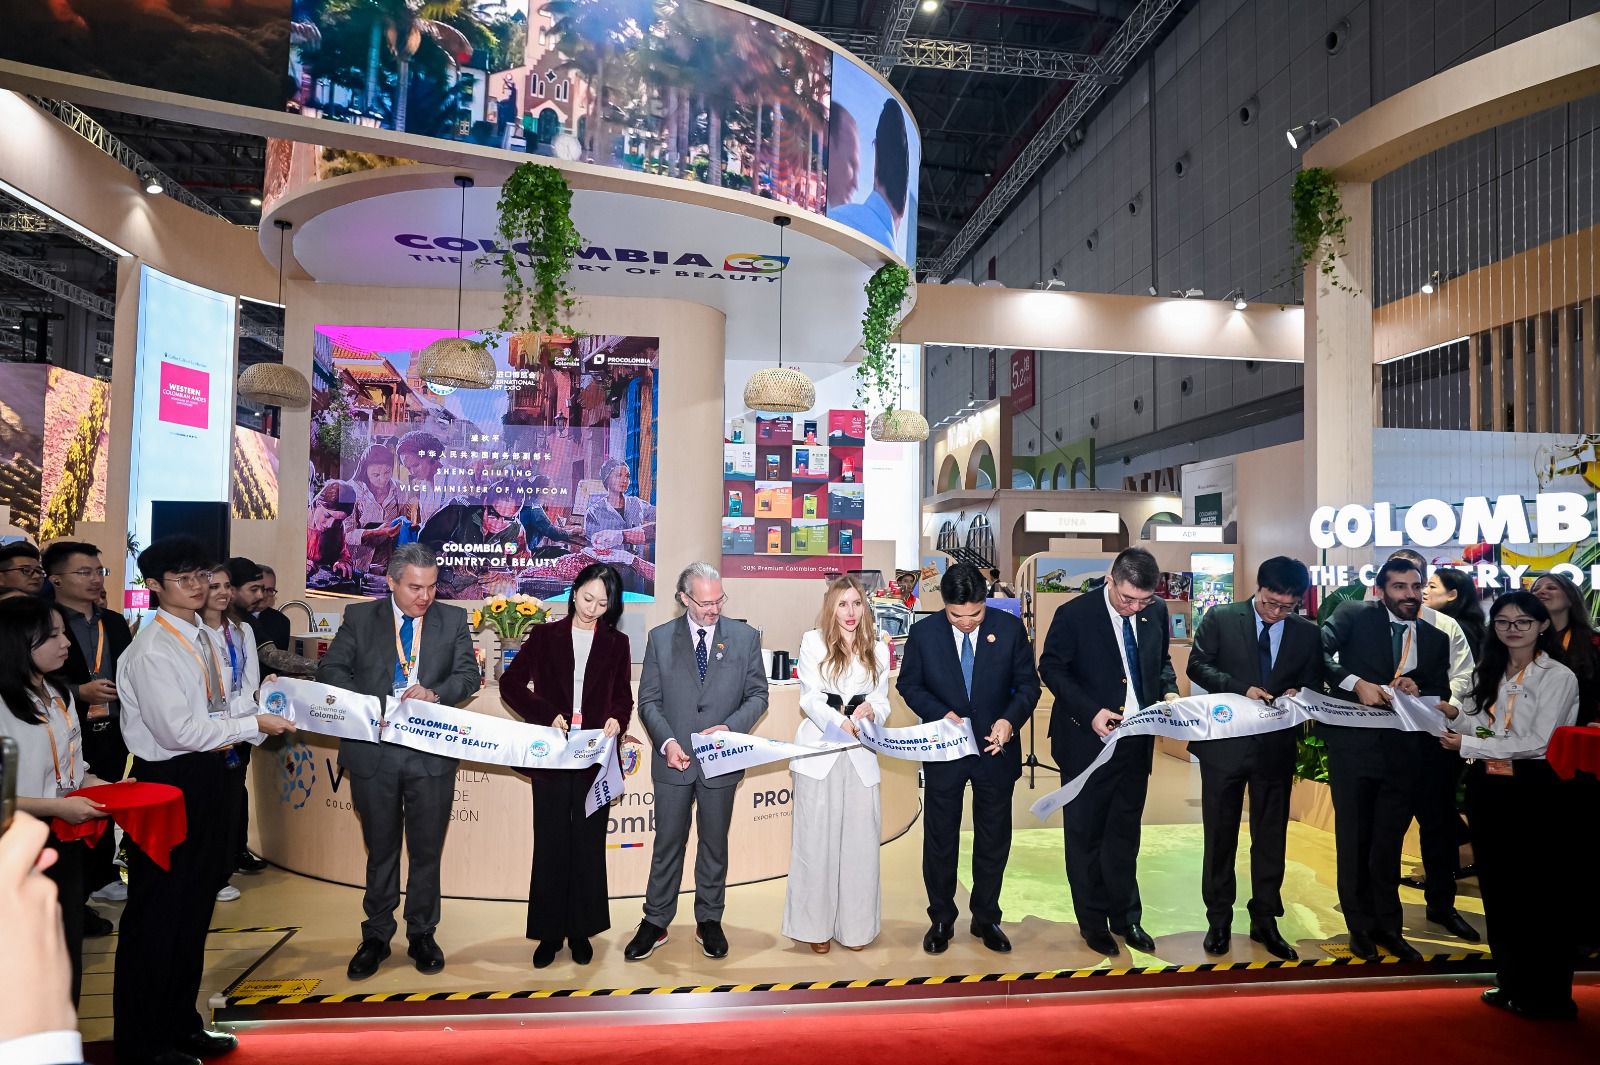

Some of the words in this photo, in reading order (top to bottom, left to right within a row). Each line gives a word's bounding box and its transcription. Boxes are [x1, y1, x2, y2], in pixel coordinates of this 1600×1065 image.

[408, 254, 462, 264] THE
[625, 267, 661, 275] OF
[675, 270, 780, 283] BEAUTY
[607, 356, 651, 364] PROCOLOMBIA
[162, 388, 191, 400] COLOMBIAN
[168, 382, 201, 397] WESTERN
[418, 450, 552, 460] 中华人民共和国商务部副部长
[436, 468, 475, 476] SHENG
[482, 468, 532, 477] QIUPING
[400, 484, 427, 492] VICE
[516, 487, 568, 495] MOFCOM
[1310, 492, 1600, 549] COLOMB
[442, 543, 503, 553] COLOMBIA
[436, 556, 486, 566] OUNTRY
[490, 557, 507, 567] OF
[511, 558, 559, 568] BEAUTY
[1309, 565, 1349, 587] THE
[310, 703, 337, 713] Gobierno
[338, 706, 347, 714] de
[1320, 706, 1354, 717] COUNTRY
[309, 709, 345, 721] Colombia
[408, 716, 459, 733] COLOMBIA
[1158, 717, 1168, 725] OF
[1169, 719, 1200, 727] BEAUTY
[394, 723, 442, 740] COUNTRY
[445, 734, 459, 743] OF
[461, 737, 499, 750] BEAUTY
[884, 736, 929, 744] COLOMBIA
[694, 743, 715, 755] MBIA
[877, 741, 917, 752] COUNTRY
[936, 736, 969, 750] BEAUTY
[708, 752, 719, 761] OF
[721, 744, 754, 758] BEAUTY
[453, 789, 470, 802] DE
[601, 780, 611, 802] COLO
[326, 798, 352, 811] COLO
[753, 788, 793, 809] PRO
[753, 812, 779, 822] EXPORTS
